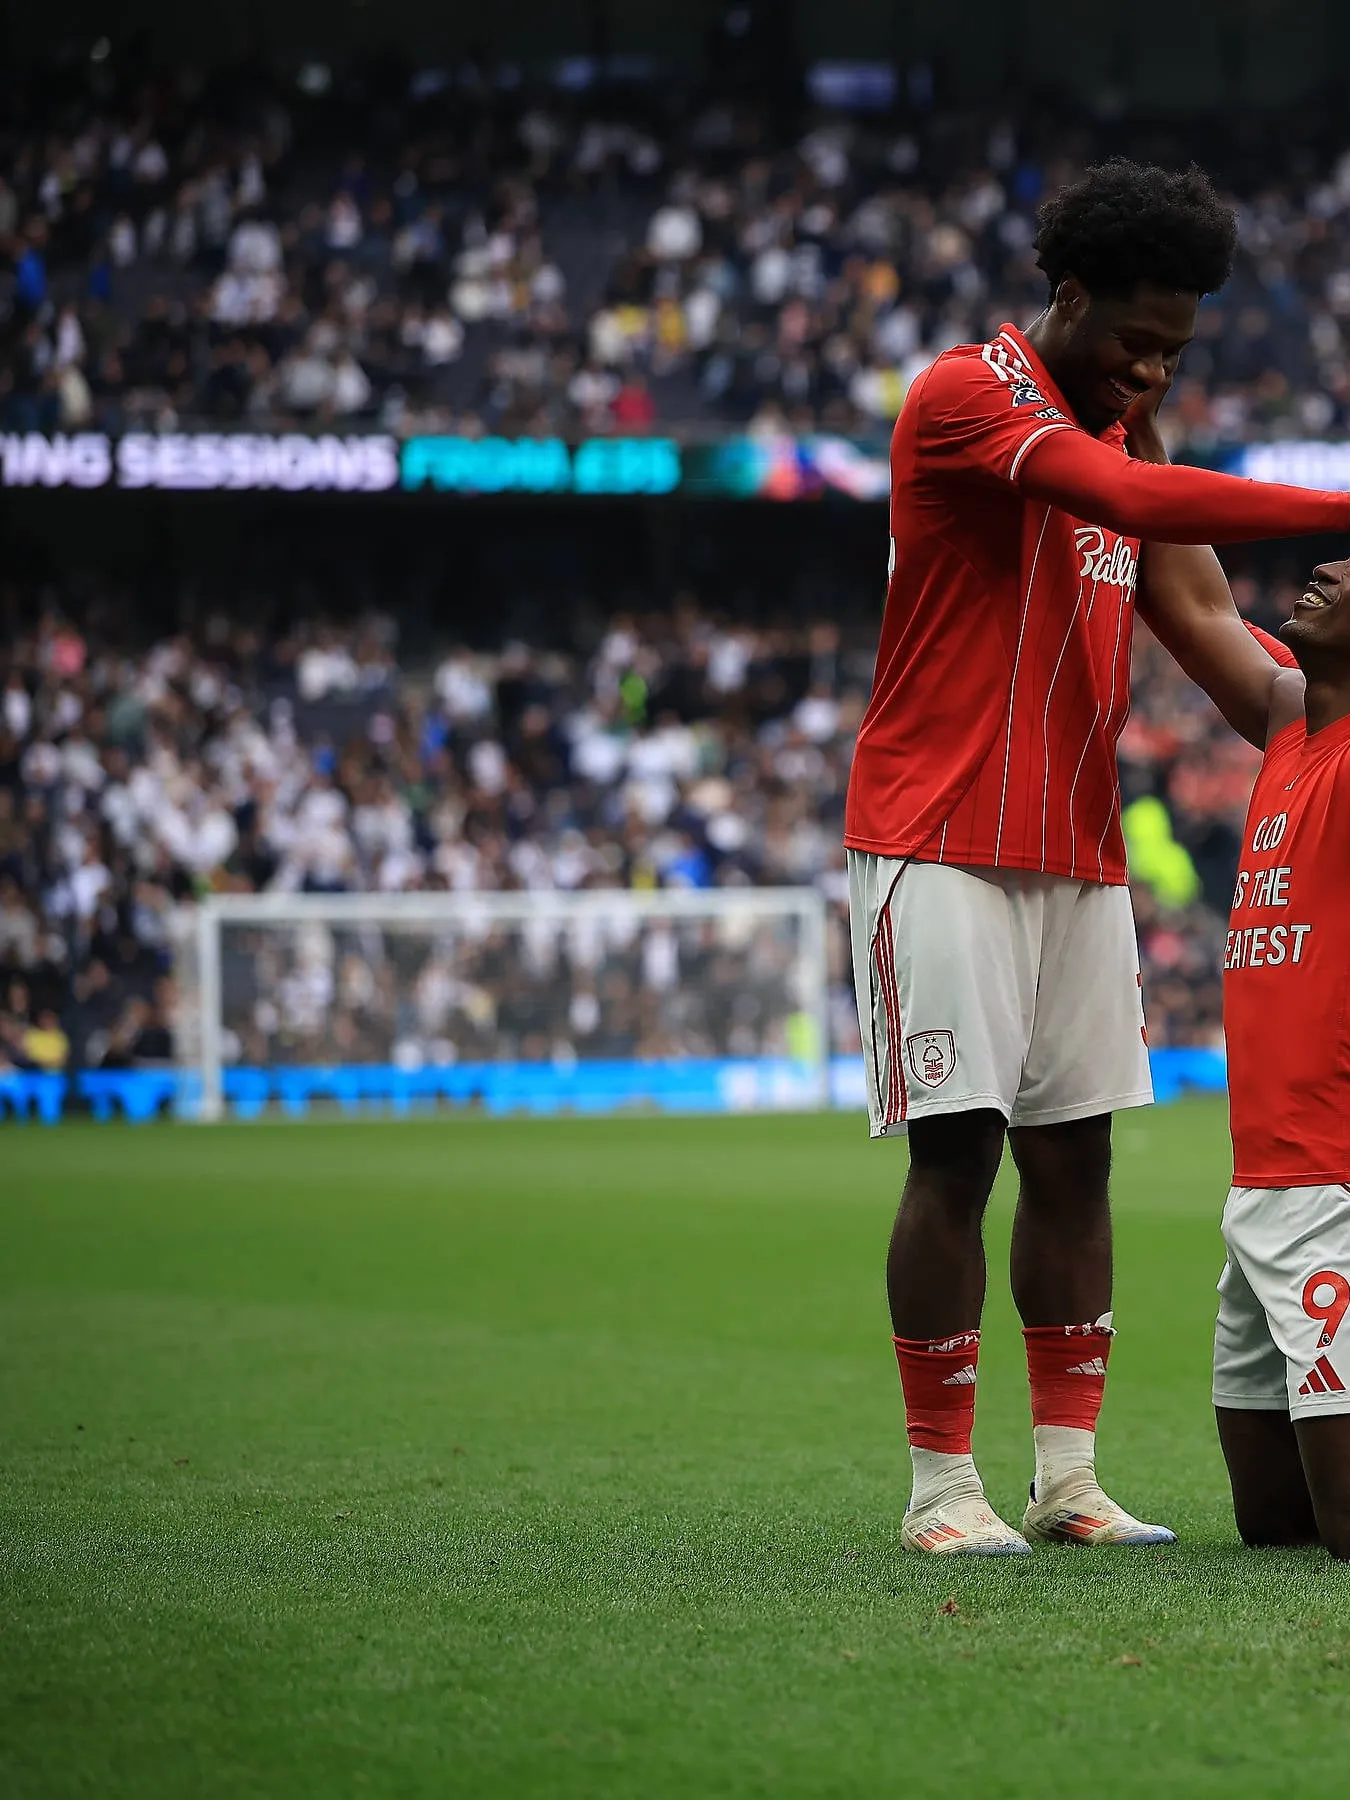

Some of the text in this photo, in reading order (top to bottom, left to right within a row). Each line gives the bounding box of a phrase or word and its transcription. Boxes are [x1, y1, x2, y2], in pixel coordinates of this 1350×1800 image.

[0, 432, 112, 489] ING
[1074, 527, 1138, 603] Bally
[1252, 812, 1288, 852] GOD
[1249, 867, 1291, 908] THE
[1223, 924, 1311, 969] EATEST
